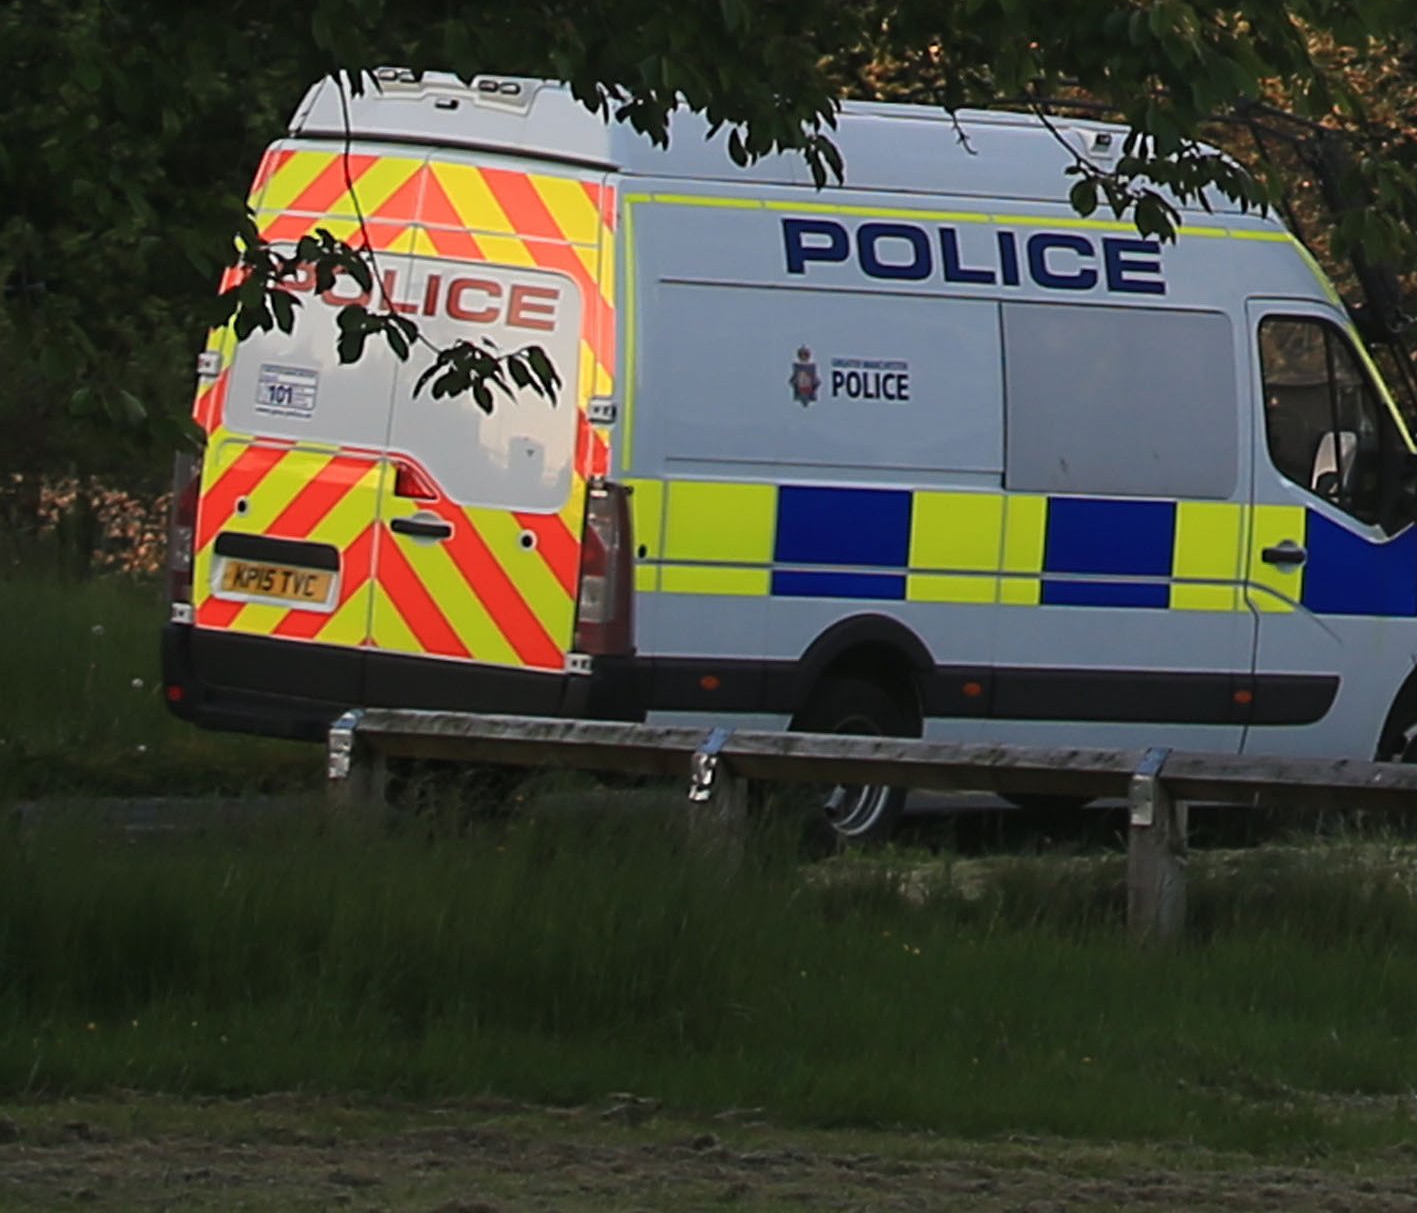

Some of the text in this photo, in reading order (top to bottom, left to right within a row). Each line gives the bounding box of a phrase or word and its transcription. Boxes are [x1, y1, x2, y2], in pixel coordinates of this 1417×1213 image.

[781, 218, 1166, 295] POLICE
[269, 385, 292, 404] 101
[832, 371, 909, 401] POLICE
[233, 564, 318, 597] KP15 TVC
